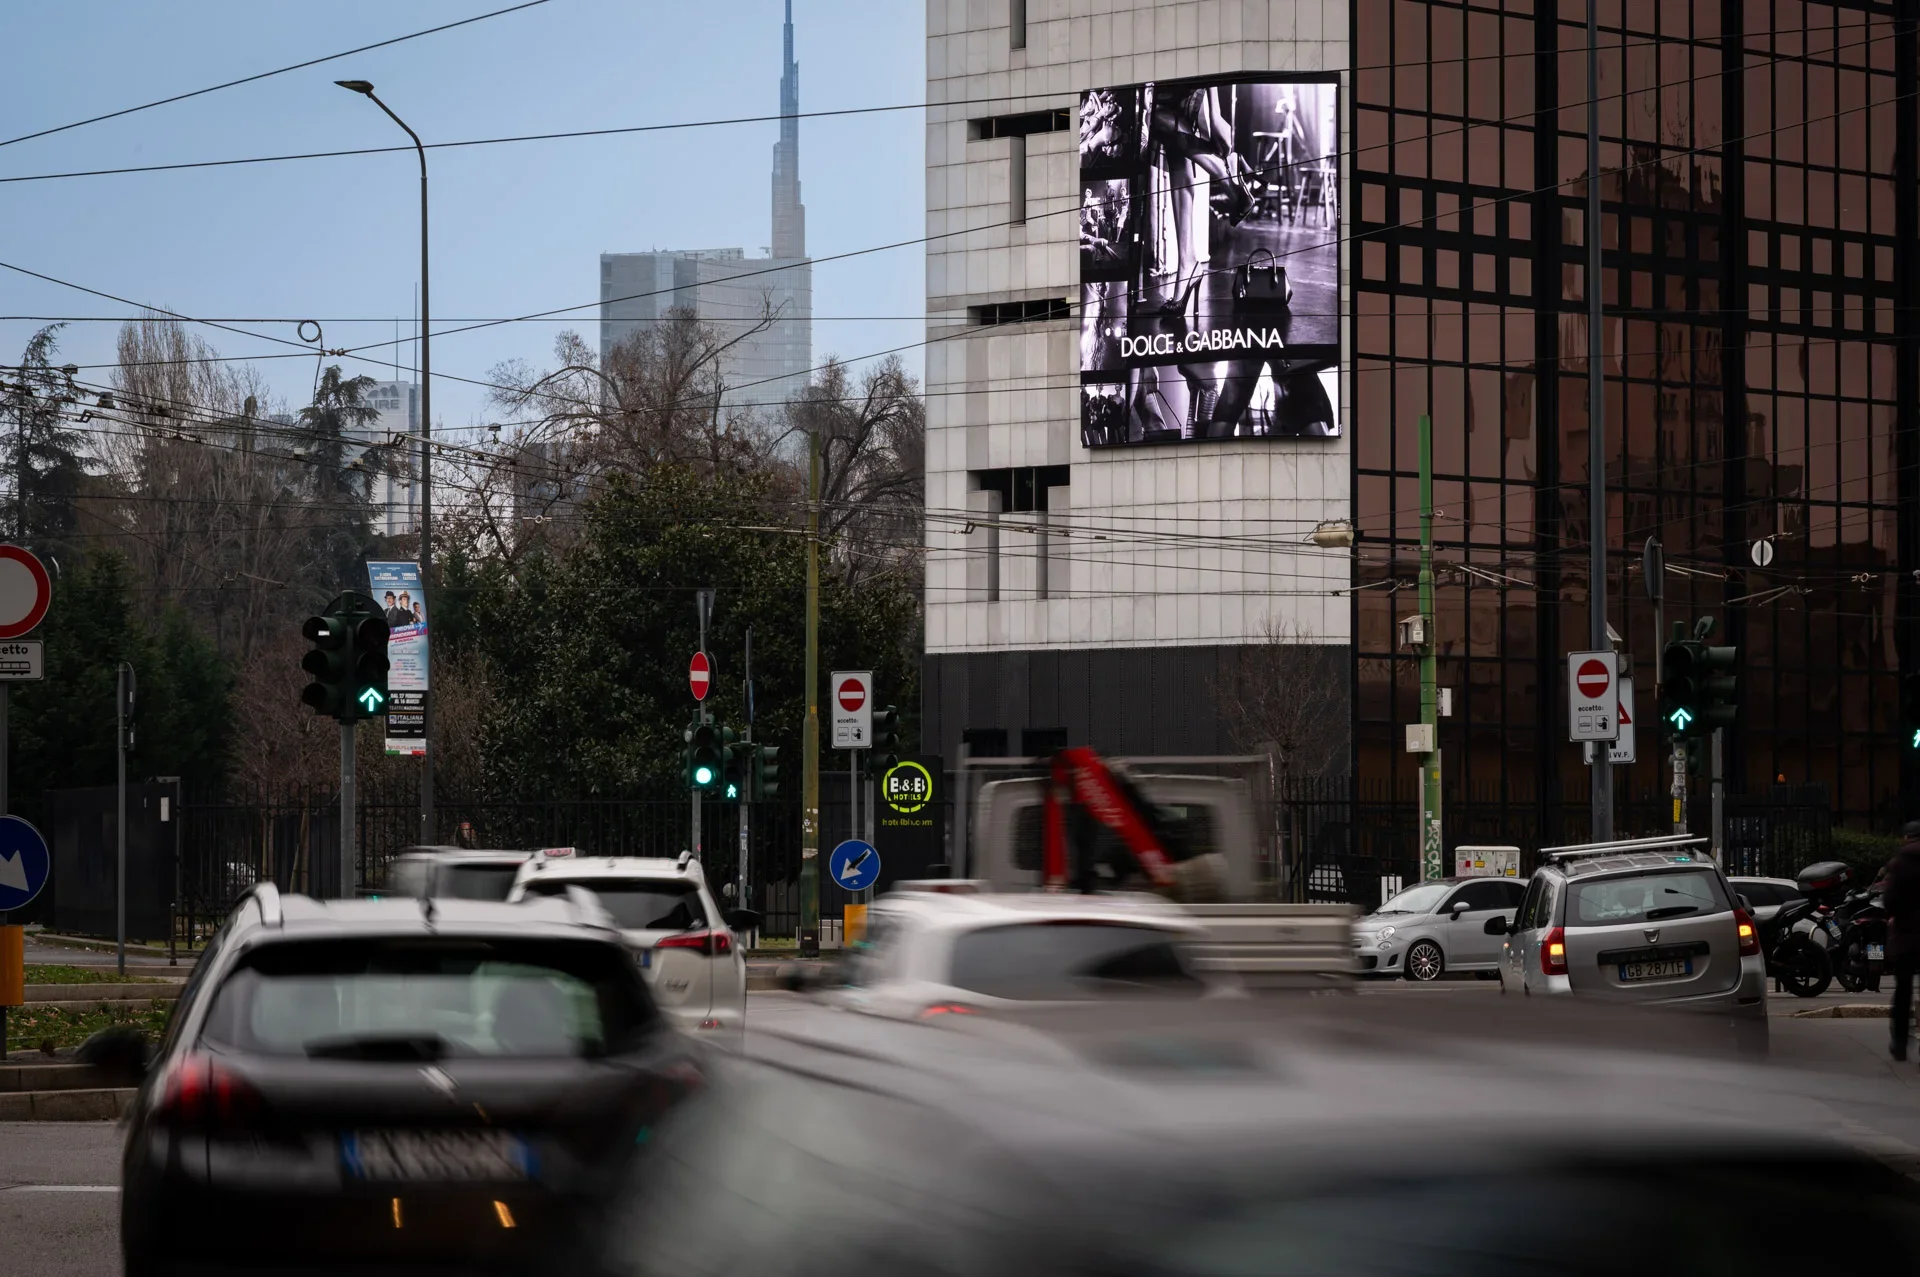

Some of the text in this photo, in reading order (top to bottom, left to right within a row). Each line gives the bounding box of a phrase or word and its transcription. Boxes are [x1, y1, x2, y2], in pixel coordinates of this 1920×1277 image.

[1121, 328, 1284, 357] DOLCE & GABBANA
[0, 644, 28, 655] etto
[890, 777, 926, 792] B&B
